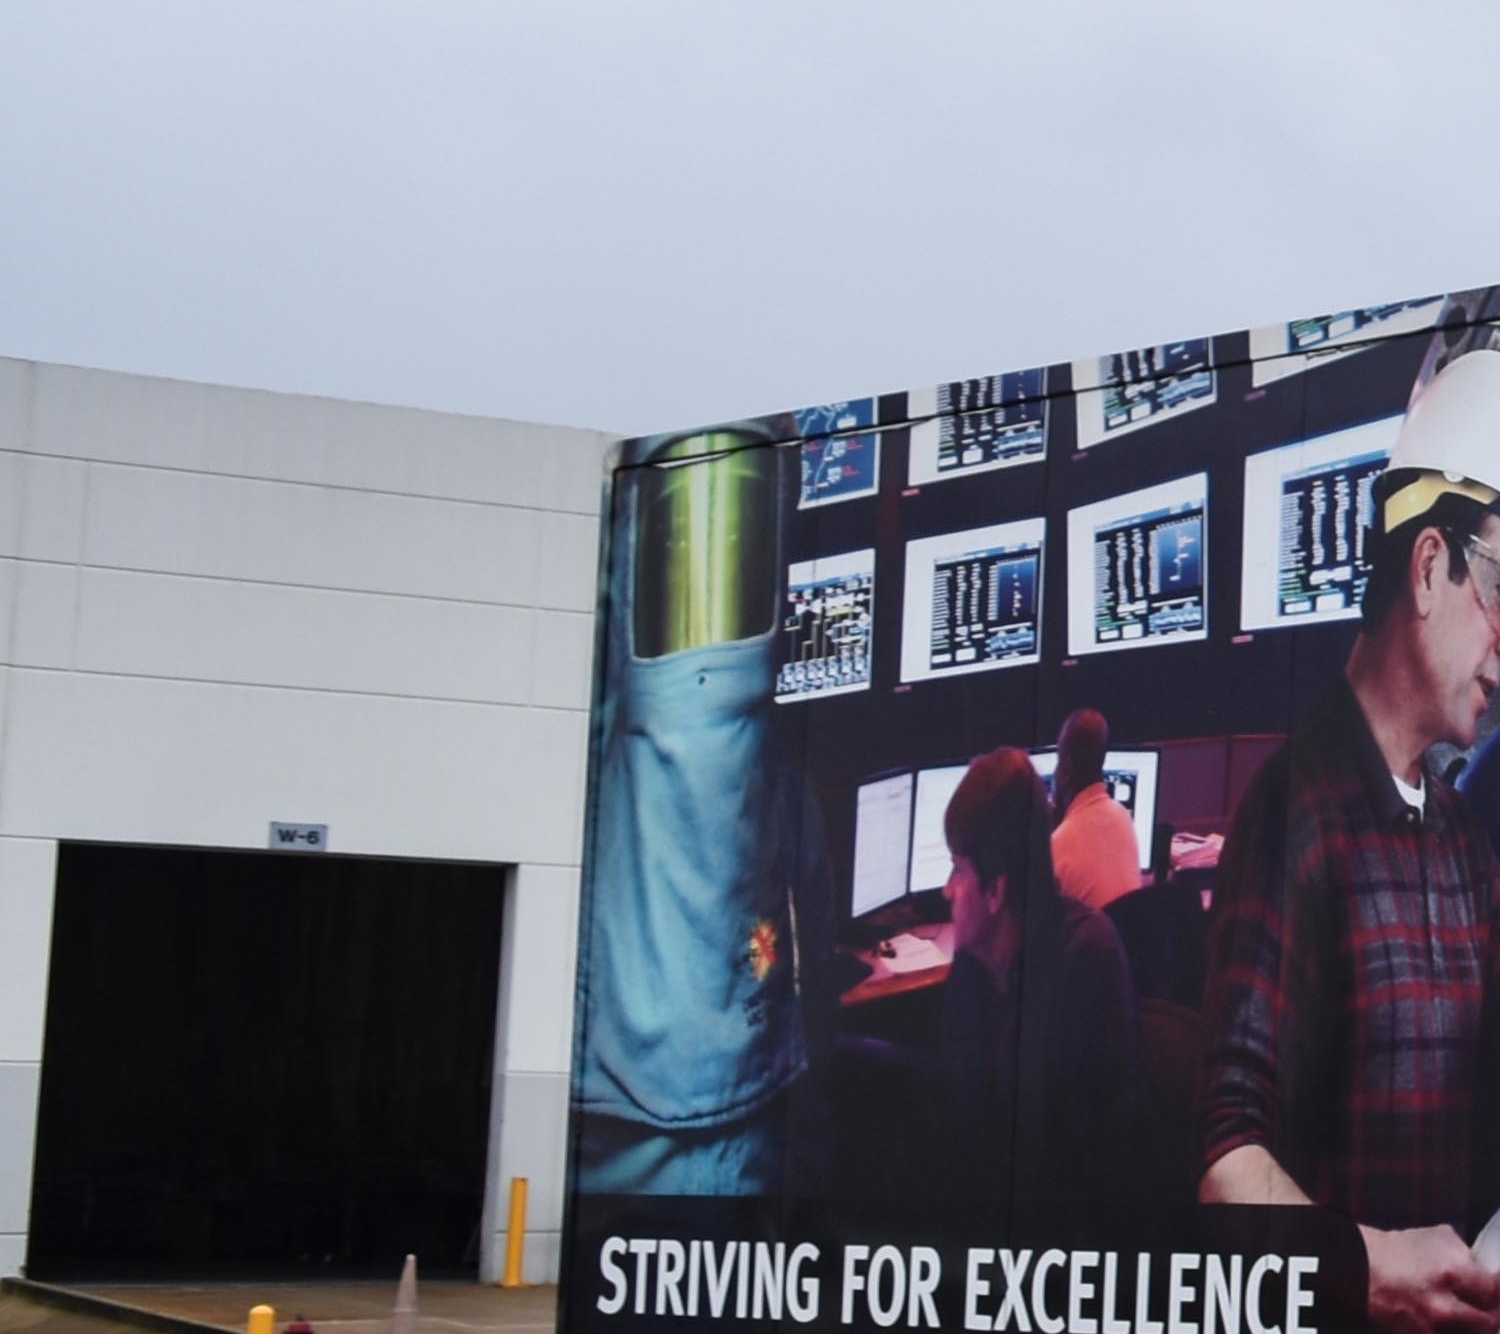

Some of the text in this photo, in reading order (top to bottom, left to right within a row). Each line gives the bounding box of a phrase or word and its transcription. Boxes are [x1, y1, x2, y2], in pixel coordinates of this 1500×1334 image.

[278, 828, 320, 845] W-6
[597, 1236, 820, 1323] STRIVING
[841, 1244, 941, 1327] FOR
